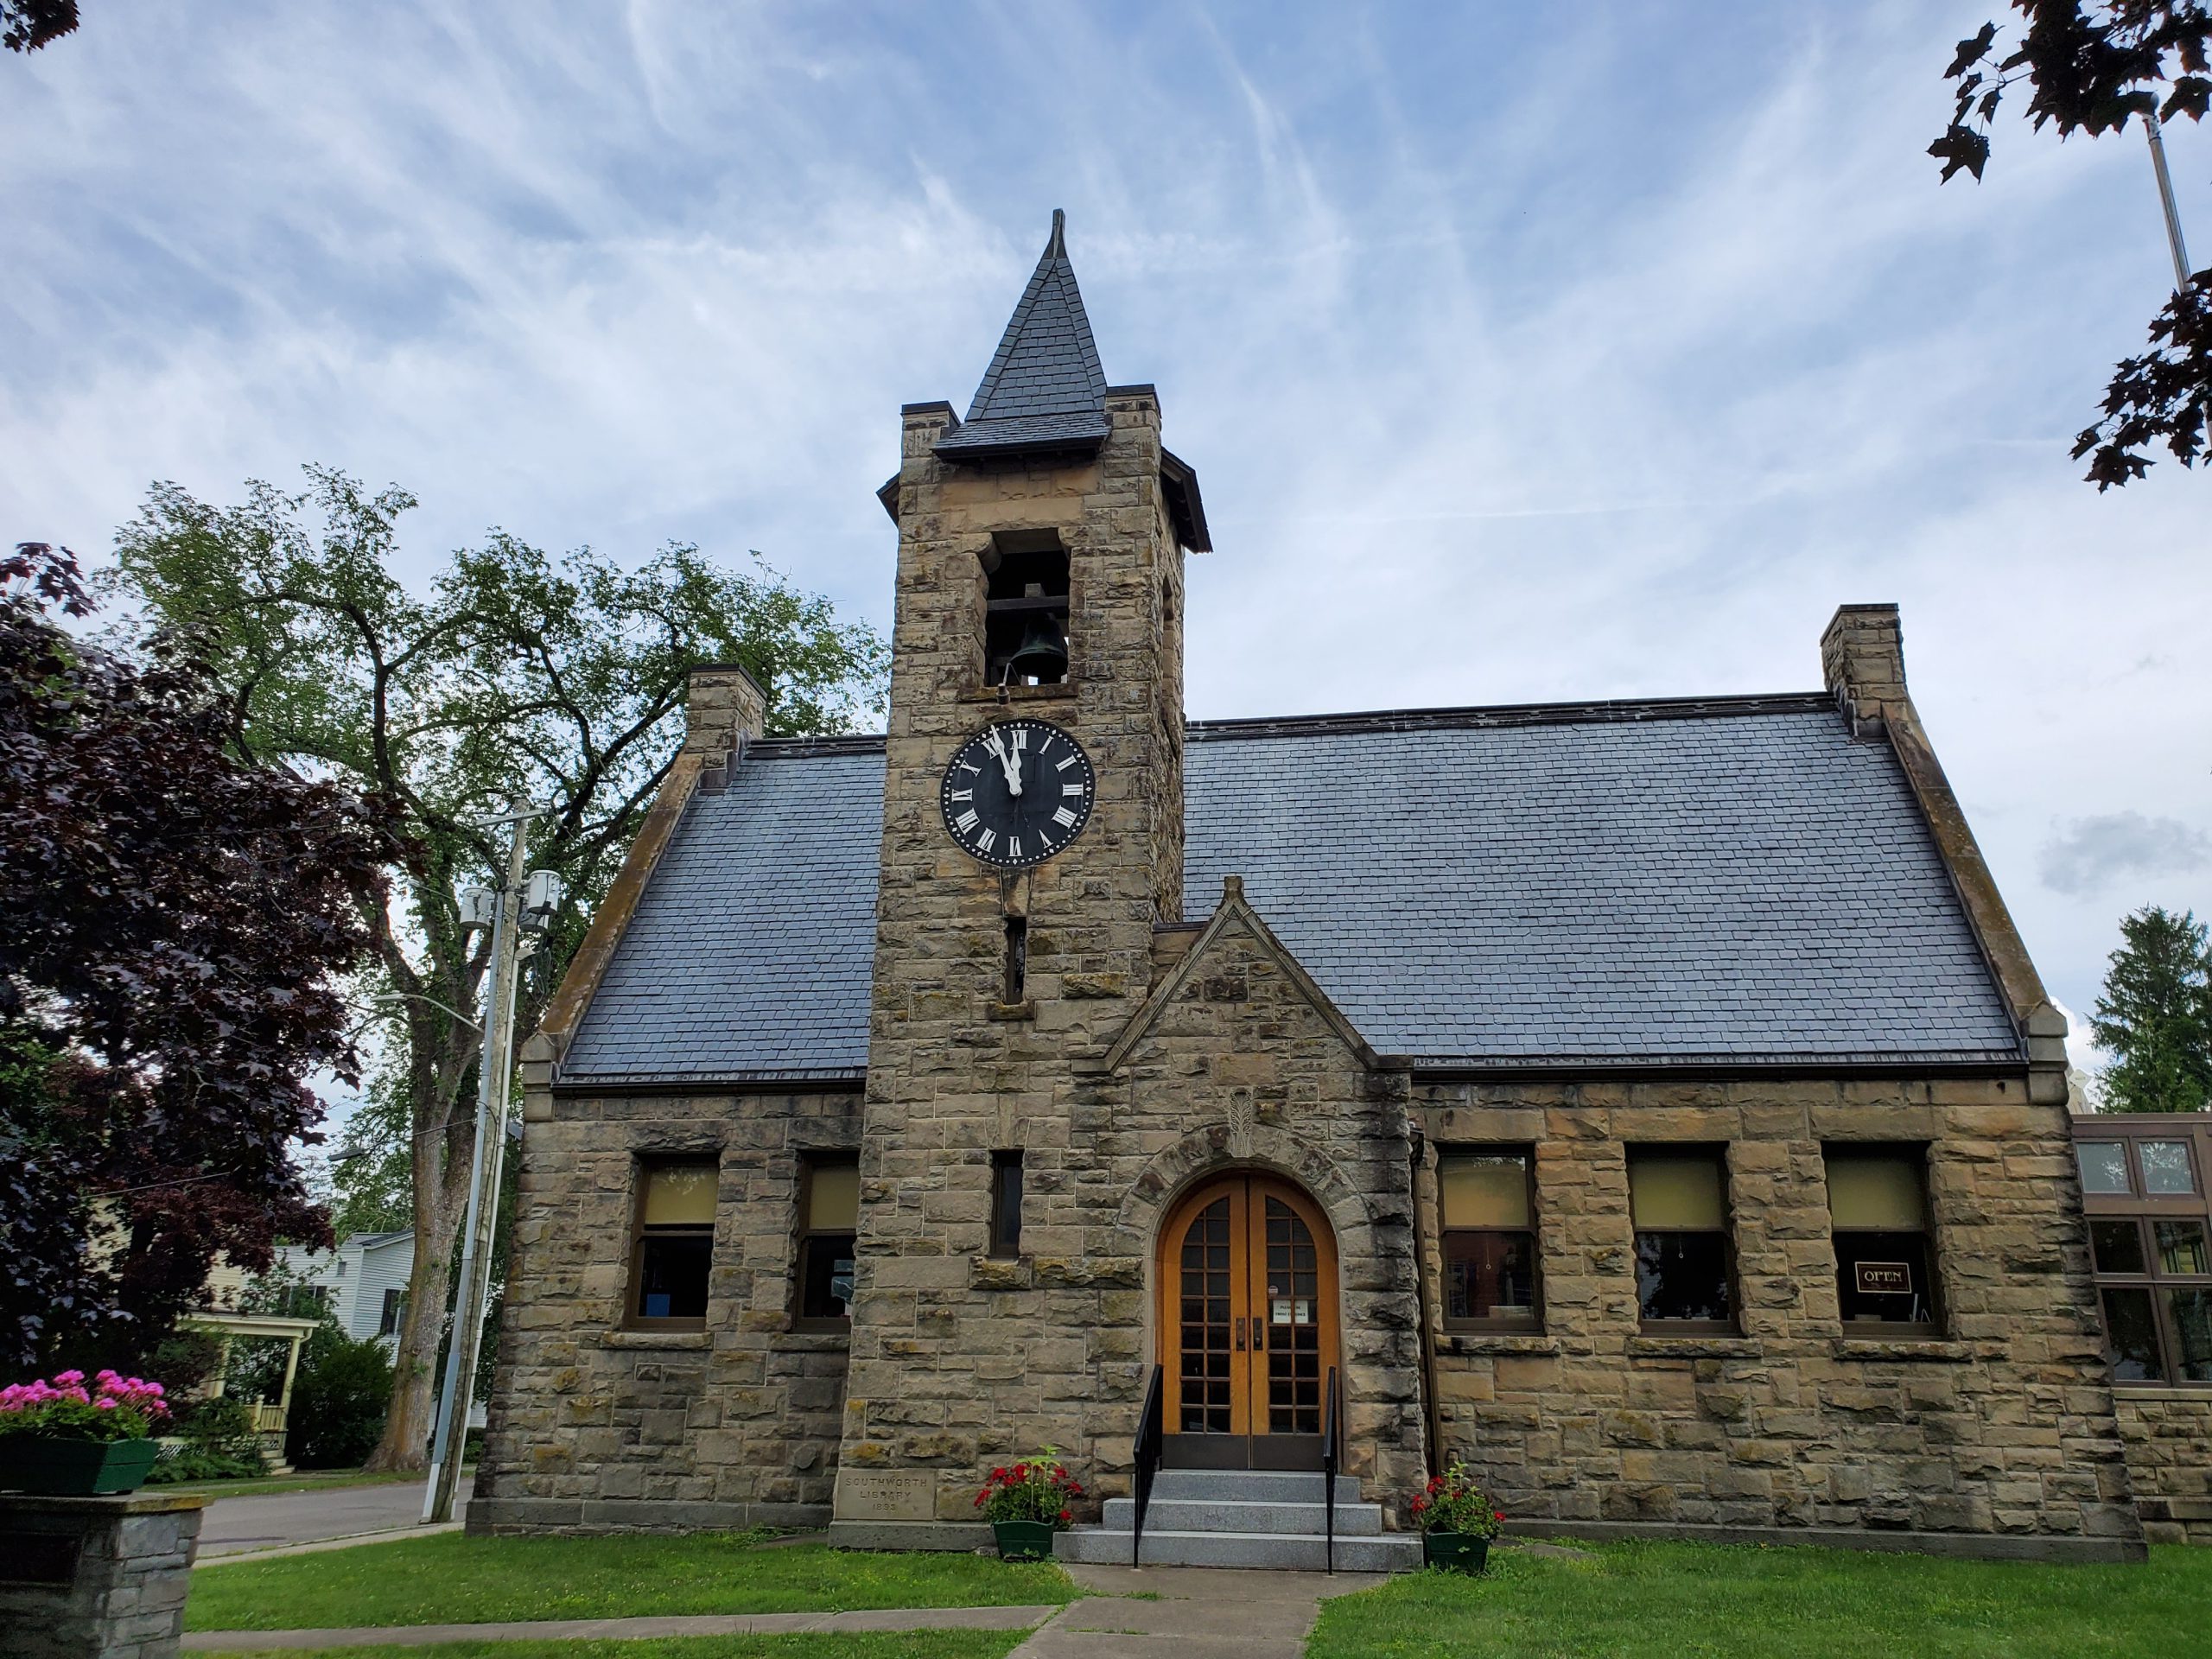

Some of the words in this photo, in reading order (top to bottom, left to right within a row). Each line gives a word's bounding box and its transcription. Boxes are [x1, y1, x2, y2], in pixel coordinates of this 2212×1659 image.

[1009, 729, 1028, 750] XII
[1039, 735, 1054, 755] I
[959, 760, 982, 778] X
[1055, 754, 1077, 772] II
[951, 787, 973, 802] IX
[1062, 783, 1084, 797] III
[955, 807, 981, 836] VIII
[1052, 804, 1077, 829] IIII
[975, 827, 997, 853] VII
[1008, 836, 1023, 857] VI
[1039, 830, 1054, 849] V
[1864, 1270, 1903, 1282] OPEN
[846, 1478, 927, 1487] SOUTHWORTH
[860, 1491, 912, 1500] LIBRARY
